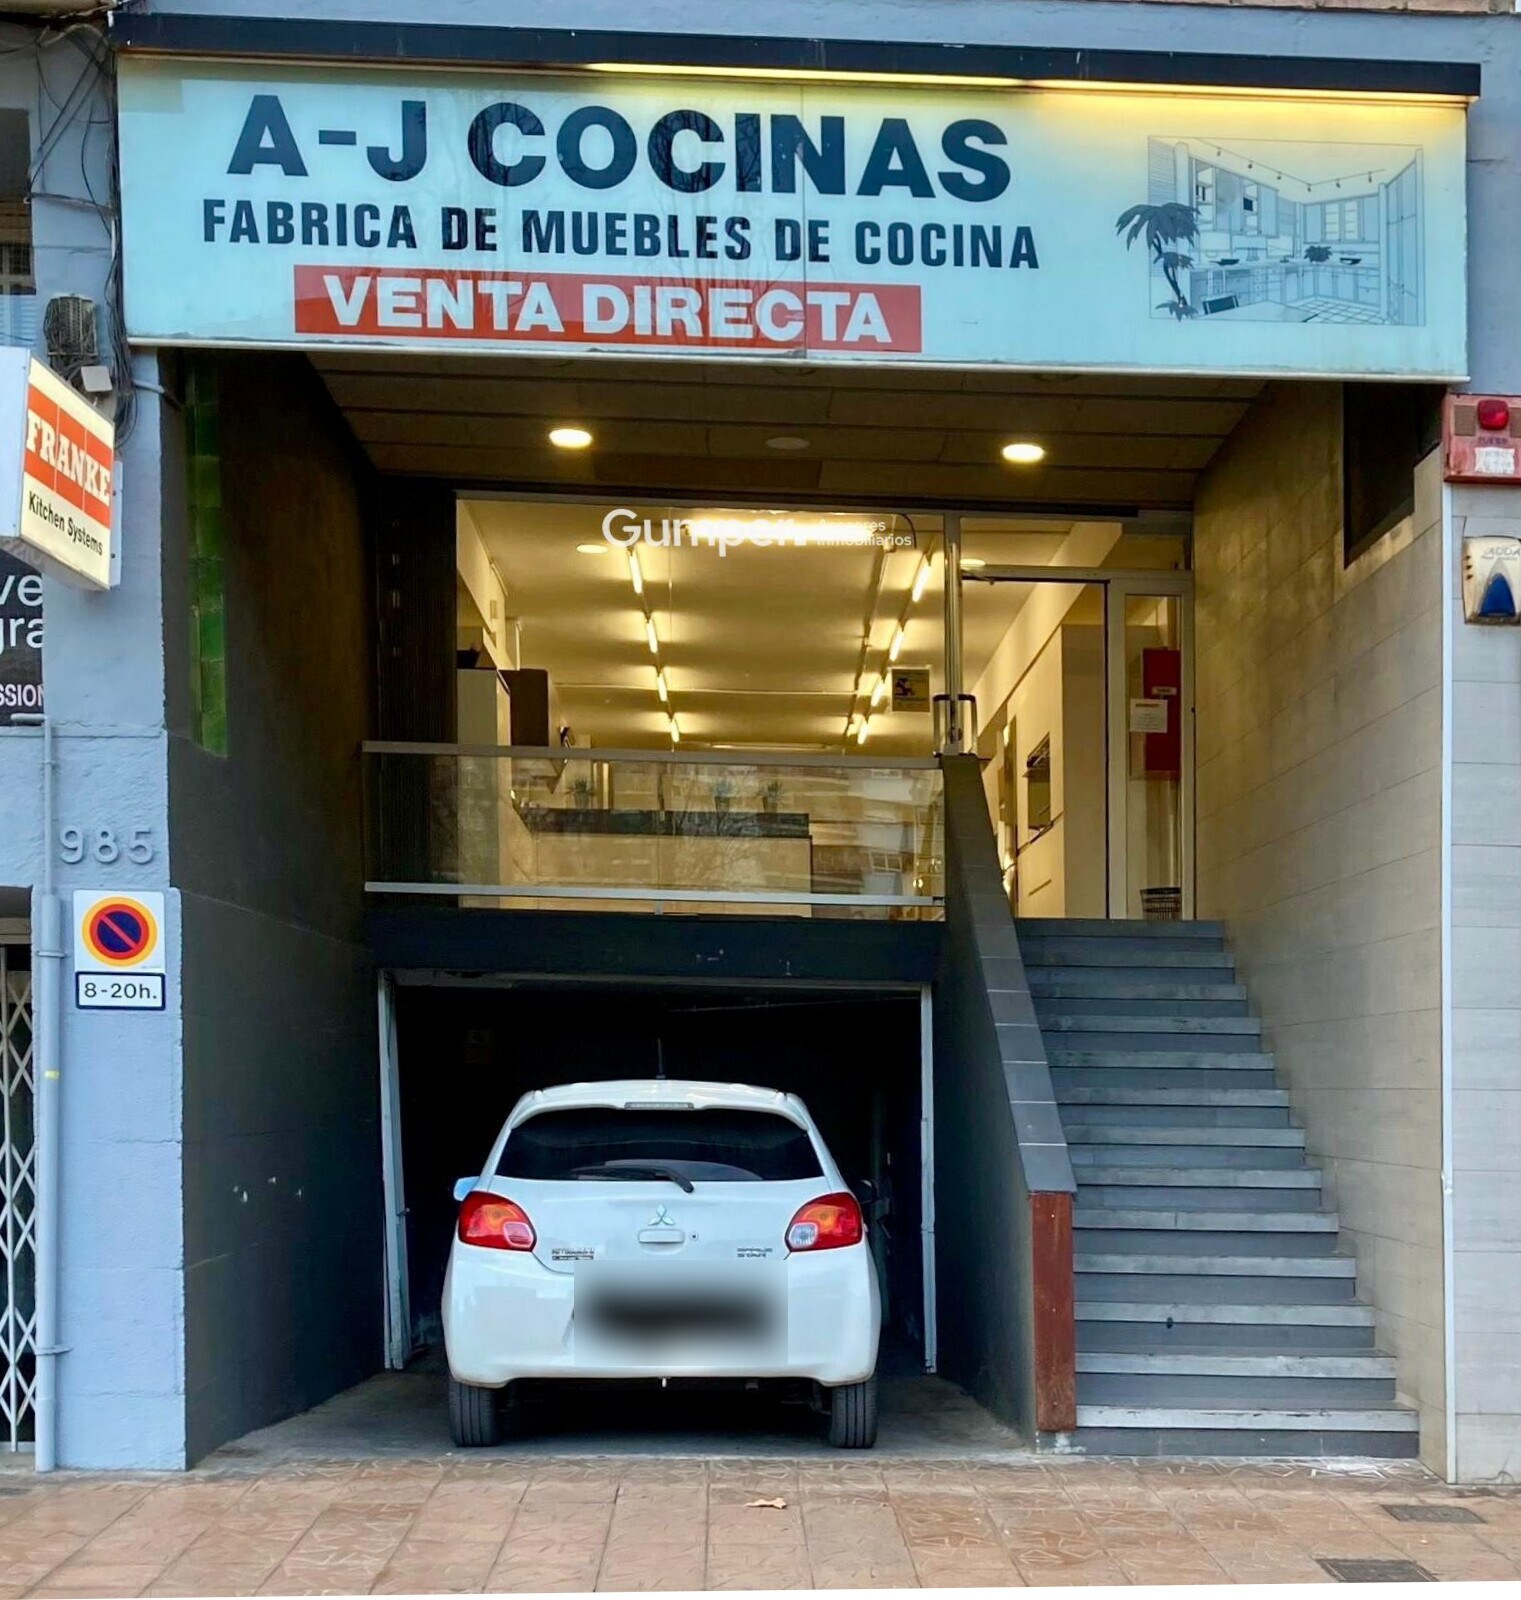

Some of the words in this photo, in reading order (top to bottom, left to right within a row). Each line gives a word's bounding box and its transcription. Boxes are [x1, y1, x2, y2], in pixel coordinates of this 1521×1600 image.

[227, 95, 427, 182] A-J
[467, 103, 1012, 202] COCINAS
[203, 199, 418, 250] FABRICA
[441, 207, 498, 253] DE
[521, 210, 751, 261] MUEBLES
[775, 218, 830, 264] DE
[855, 221, 1039, 270] COCINA
[322, 274, 565, 335] VENTA
[582, 283, 892, 344] DIRECTA
[26, 408, 111, 506] FRANKE
[29, 491, 65, 532] Kitchen
[67, 517, 103, 556] Systems
[60, 825, 154, 864] 985
